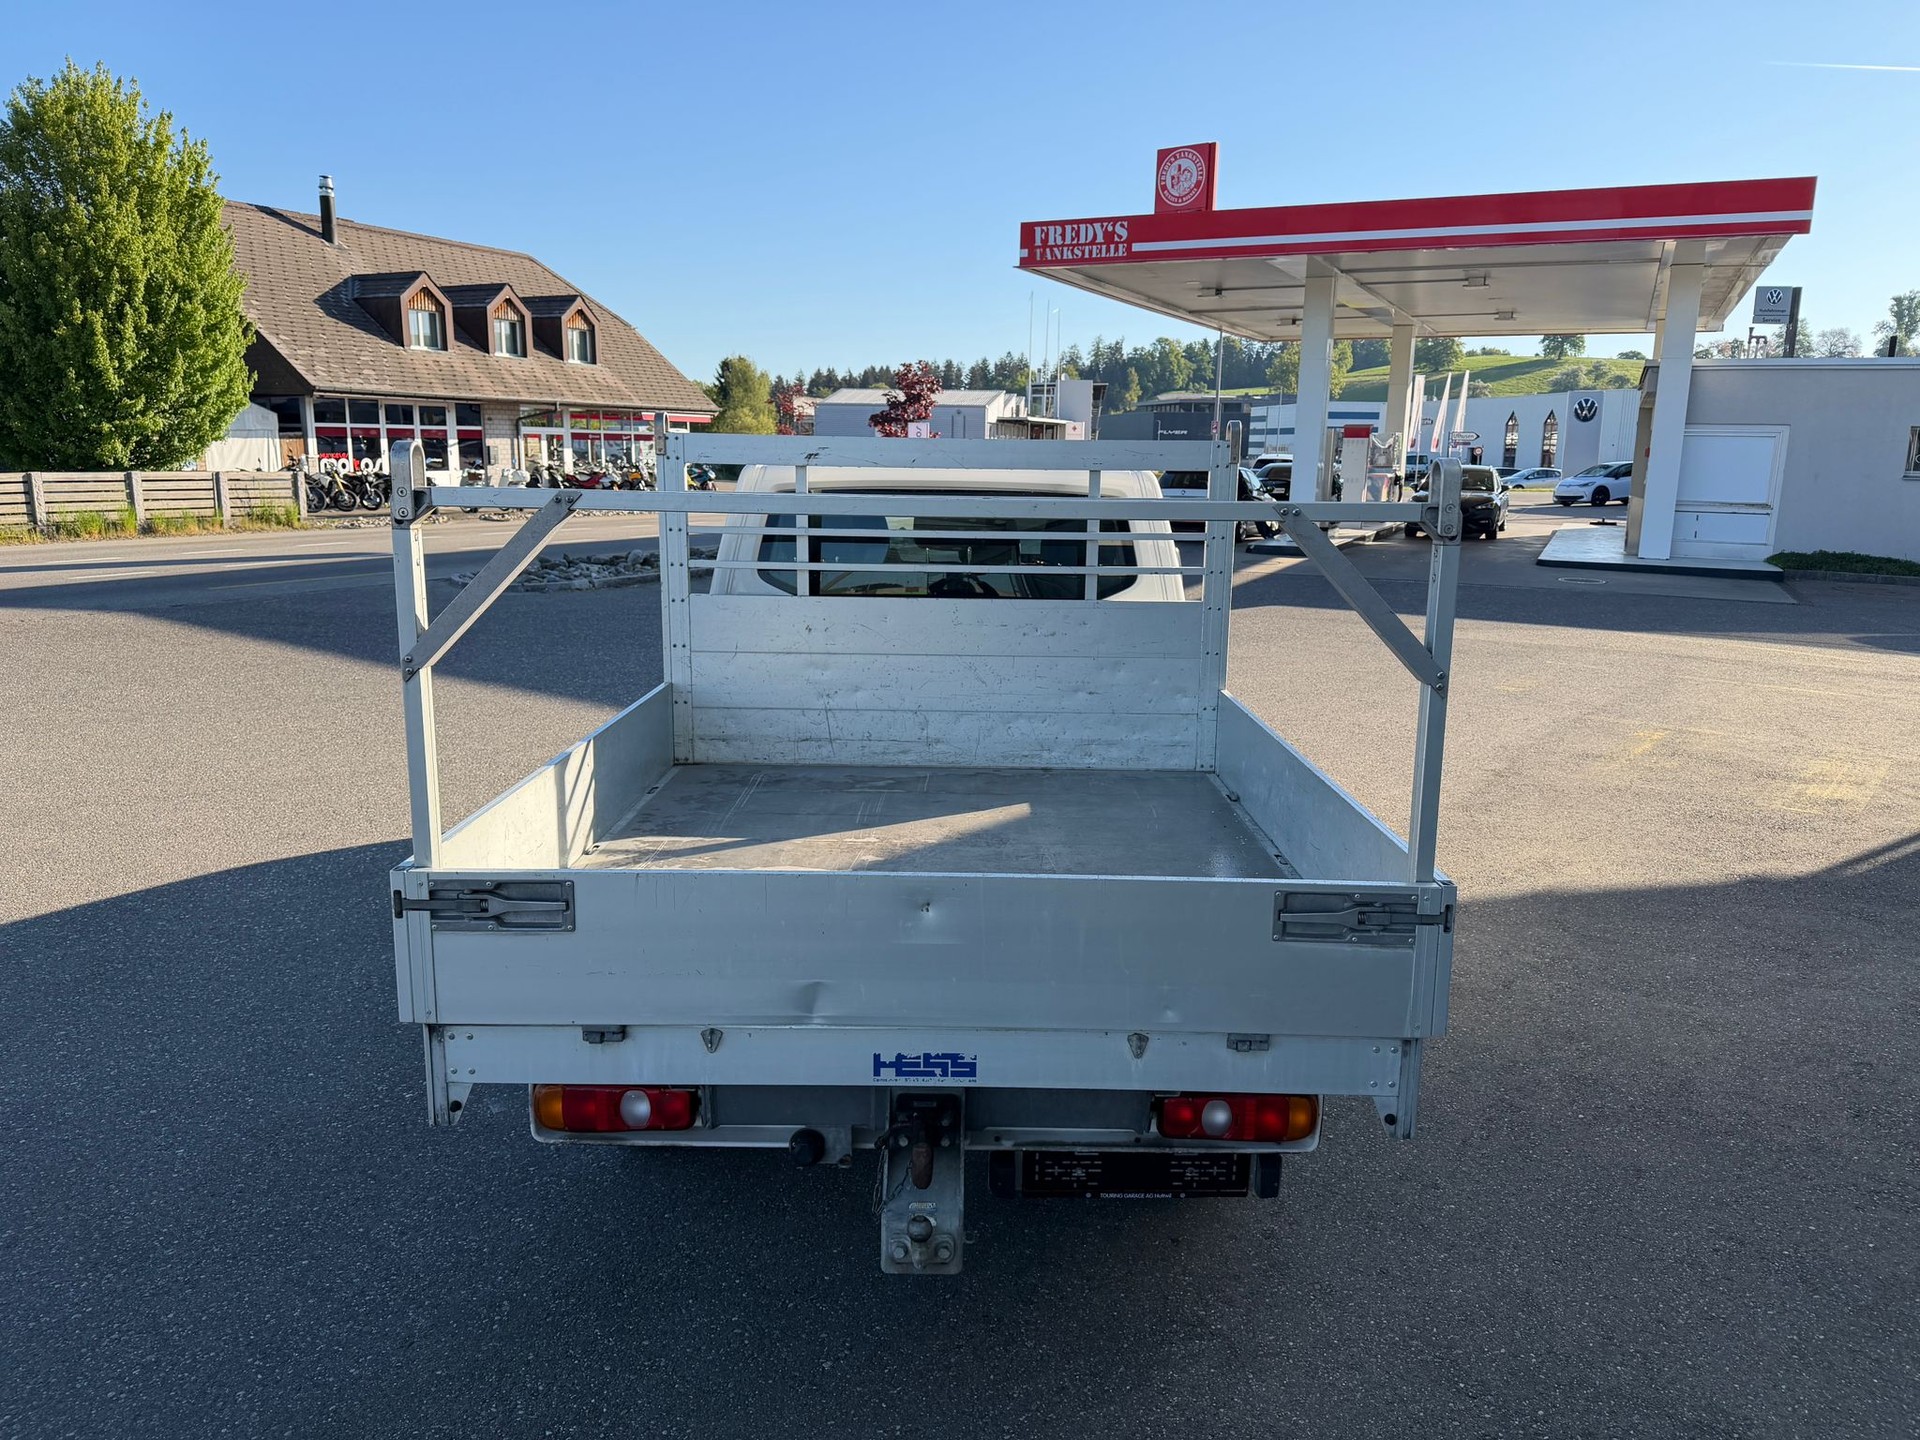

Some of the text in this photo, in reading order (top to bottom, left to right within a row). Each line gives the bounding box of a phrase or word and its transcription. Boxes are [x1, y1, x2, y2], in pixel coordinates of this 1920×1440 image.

[1034, 220, 1128, 246] FREDY'S
[1035, 243, 1128, 261] TANKSTELLE
[873, 1052, 977, 1078] HESS
